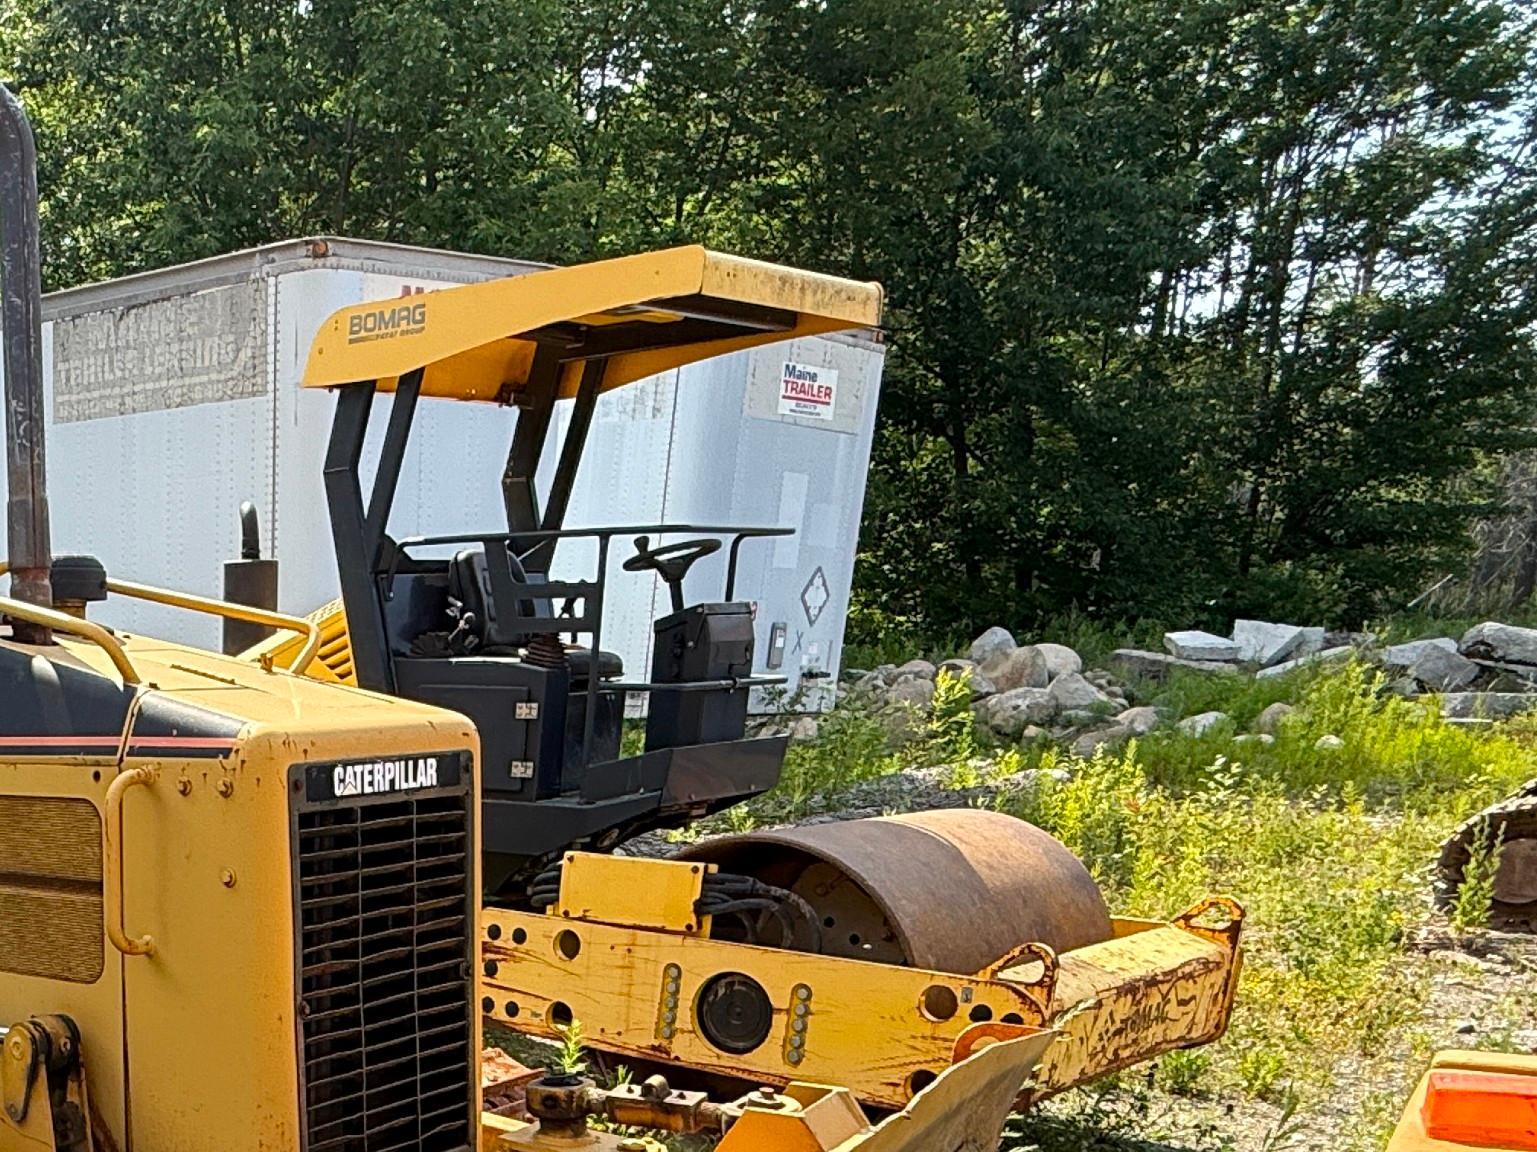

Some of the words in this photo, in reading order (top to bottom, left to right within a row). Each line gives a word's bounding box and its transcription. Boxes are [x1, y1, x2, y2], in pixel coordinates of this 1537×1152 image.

[348, 303, 426, 336] BOMAG
[784, 363, 818, 383] Maine
[783, 379, 833, 401] TRAILER
[333, 757, 438, 797] CATERPILLAR
